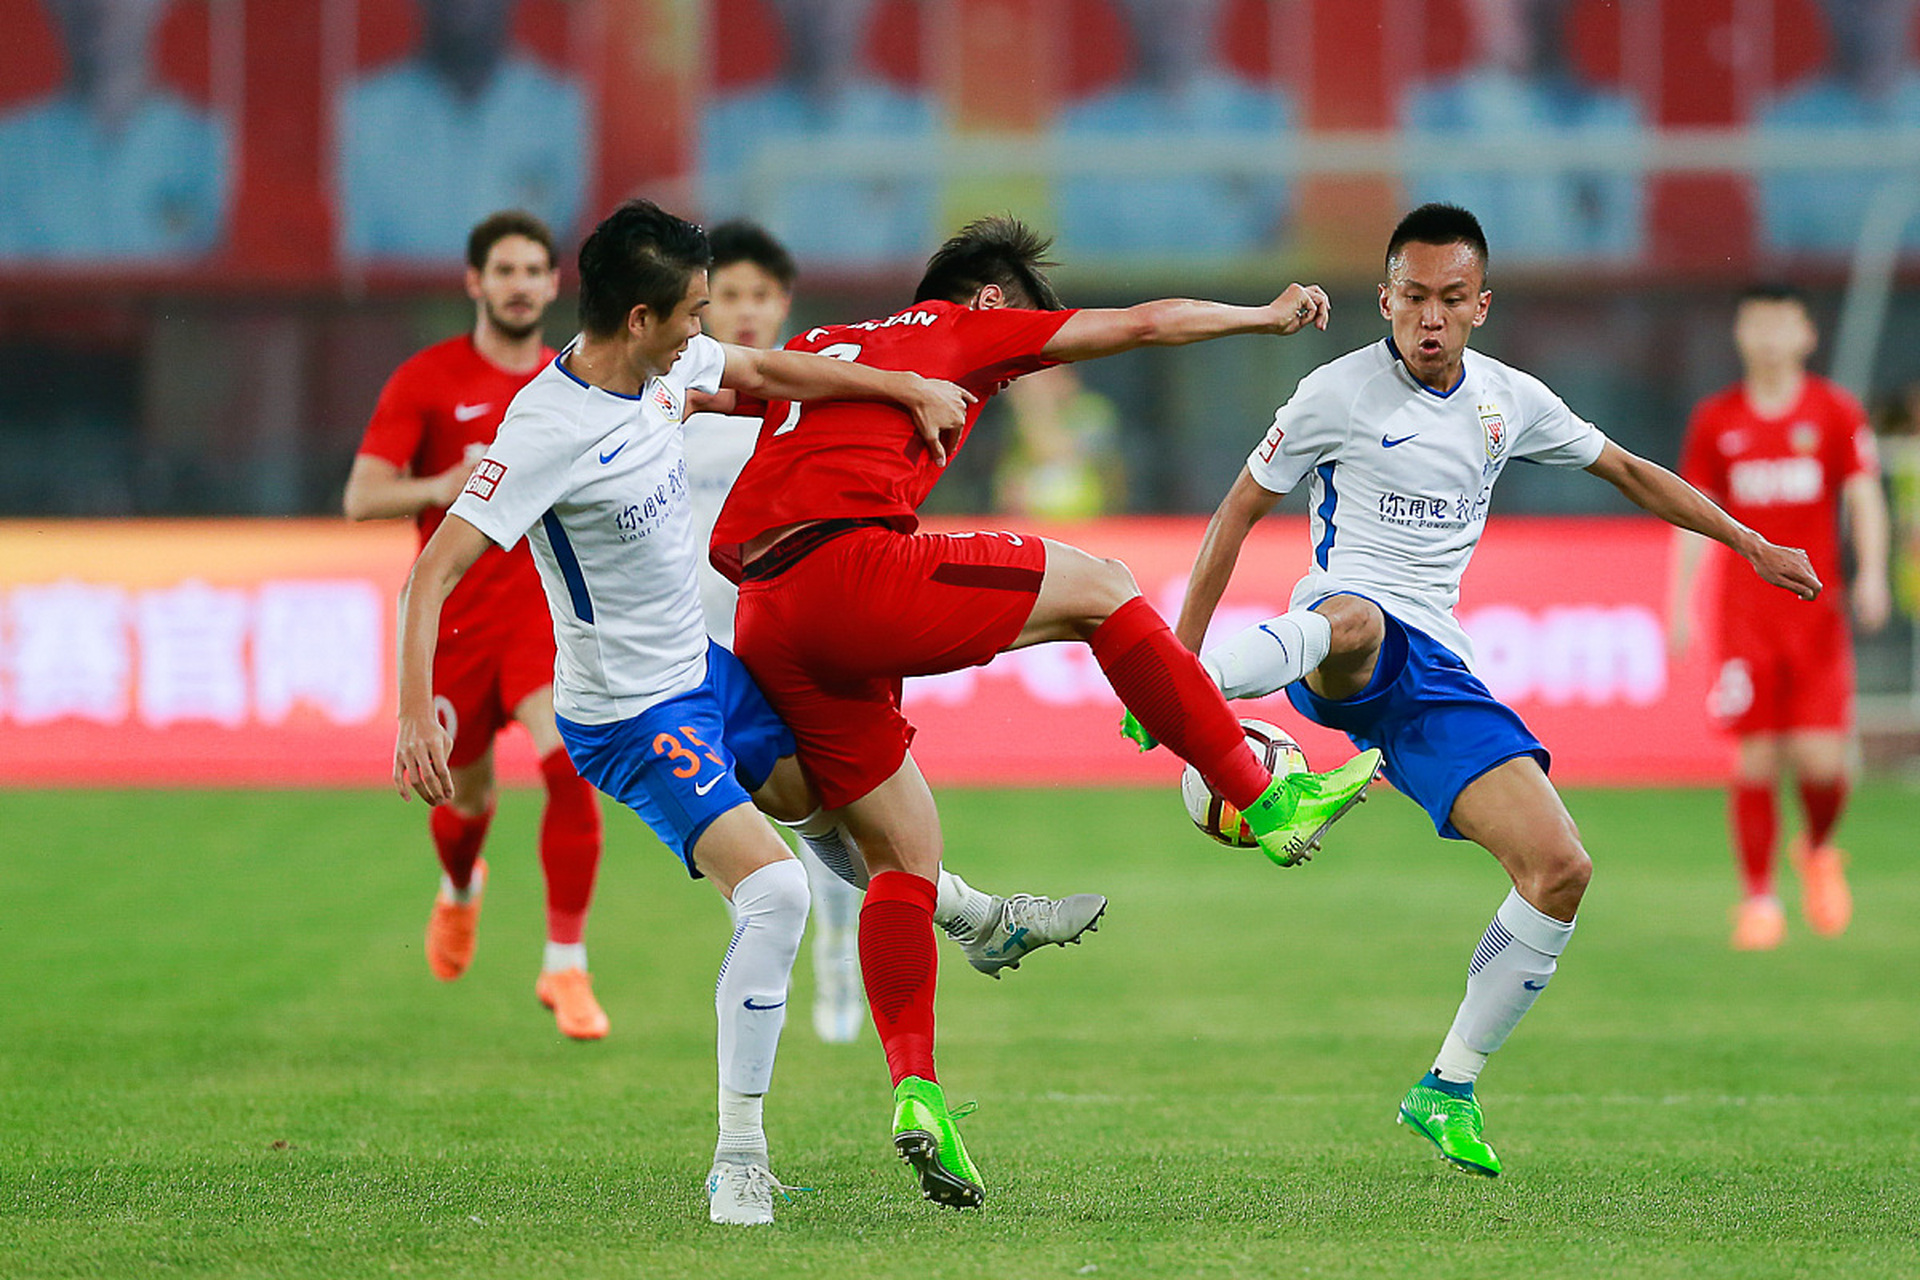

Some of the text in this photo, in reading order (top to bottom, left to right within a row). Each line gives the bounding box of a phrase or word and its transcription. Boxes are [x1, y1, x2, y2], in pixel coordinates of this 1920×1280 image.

[1378, 492, 1448, 519] 你用电
[1378, 514, 1412, 527] Your
[619, 526, 651, 543] Your
